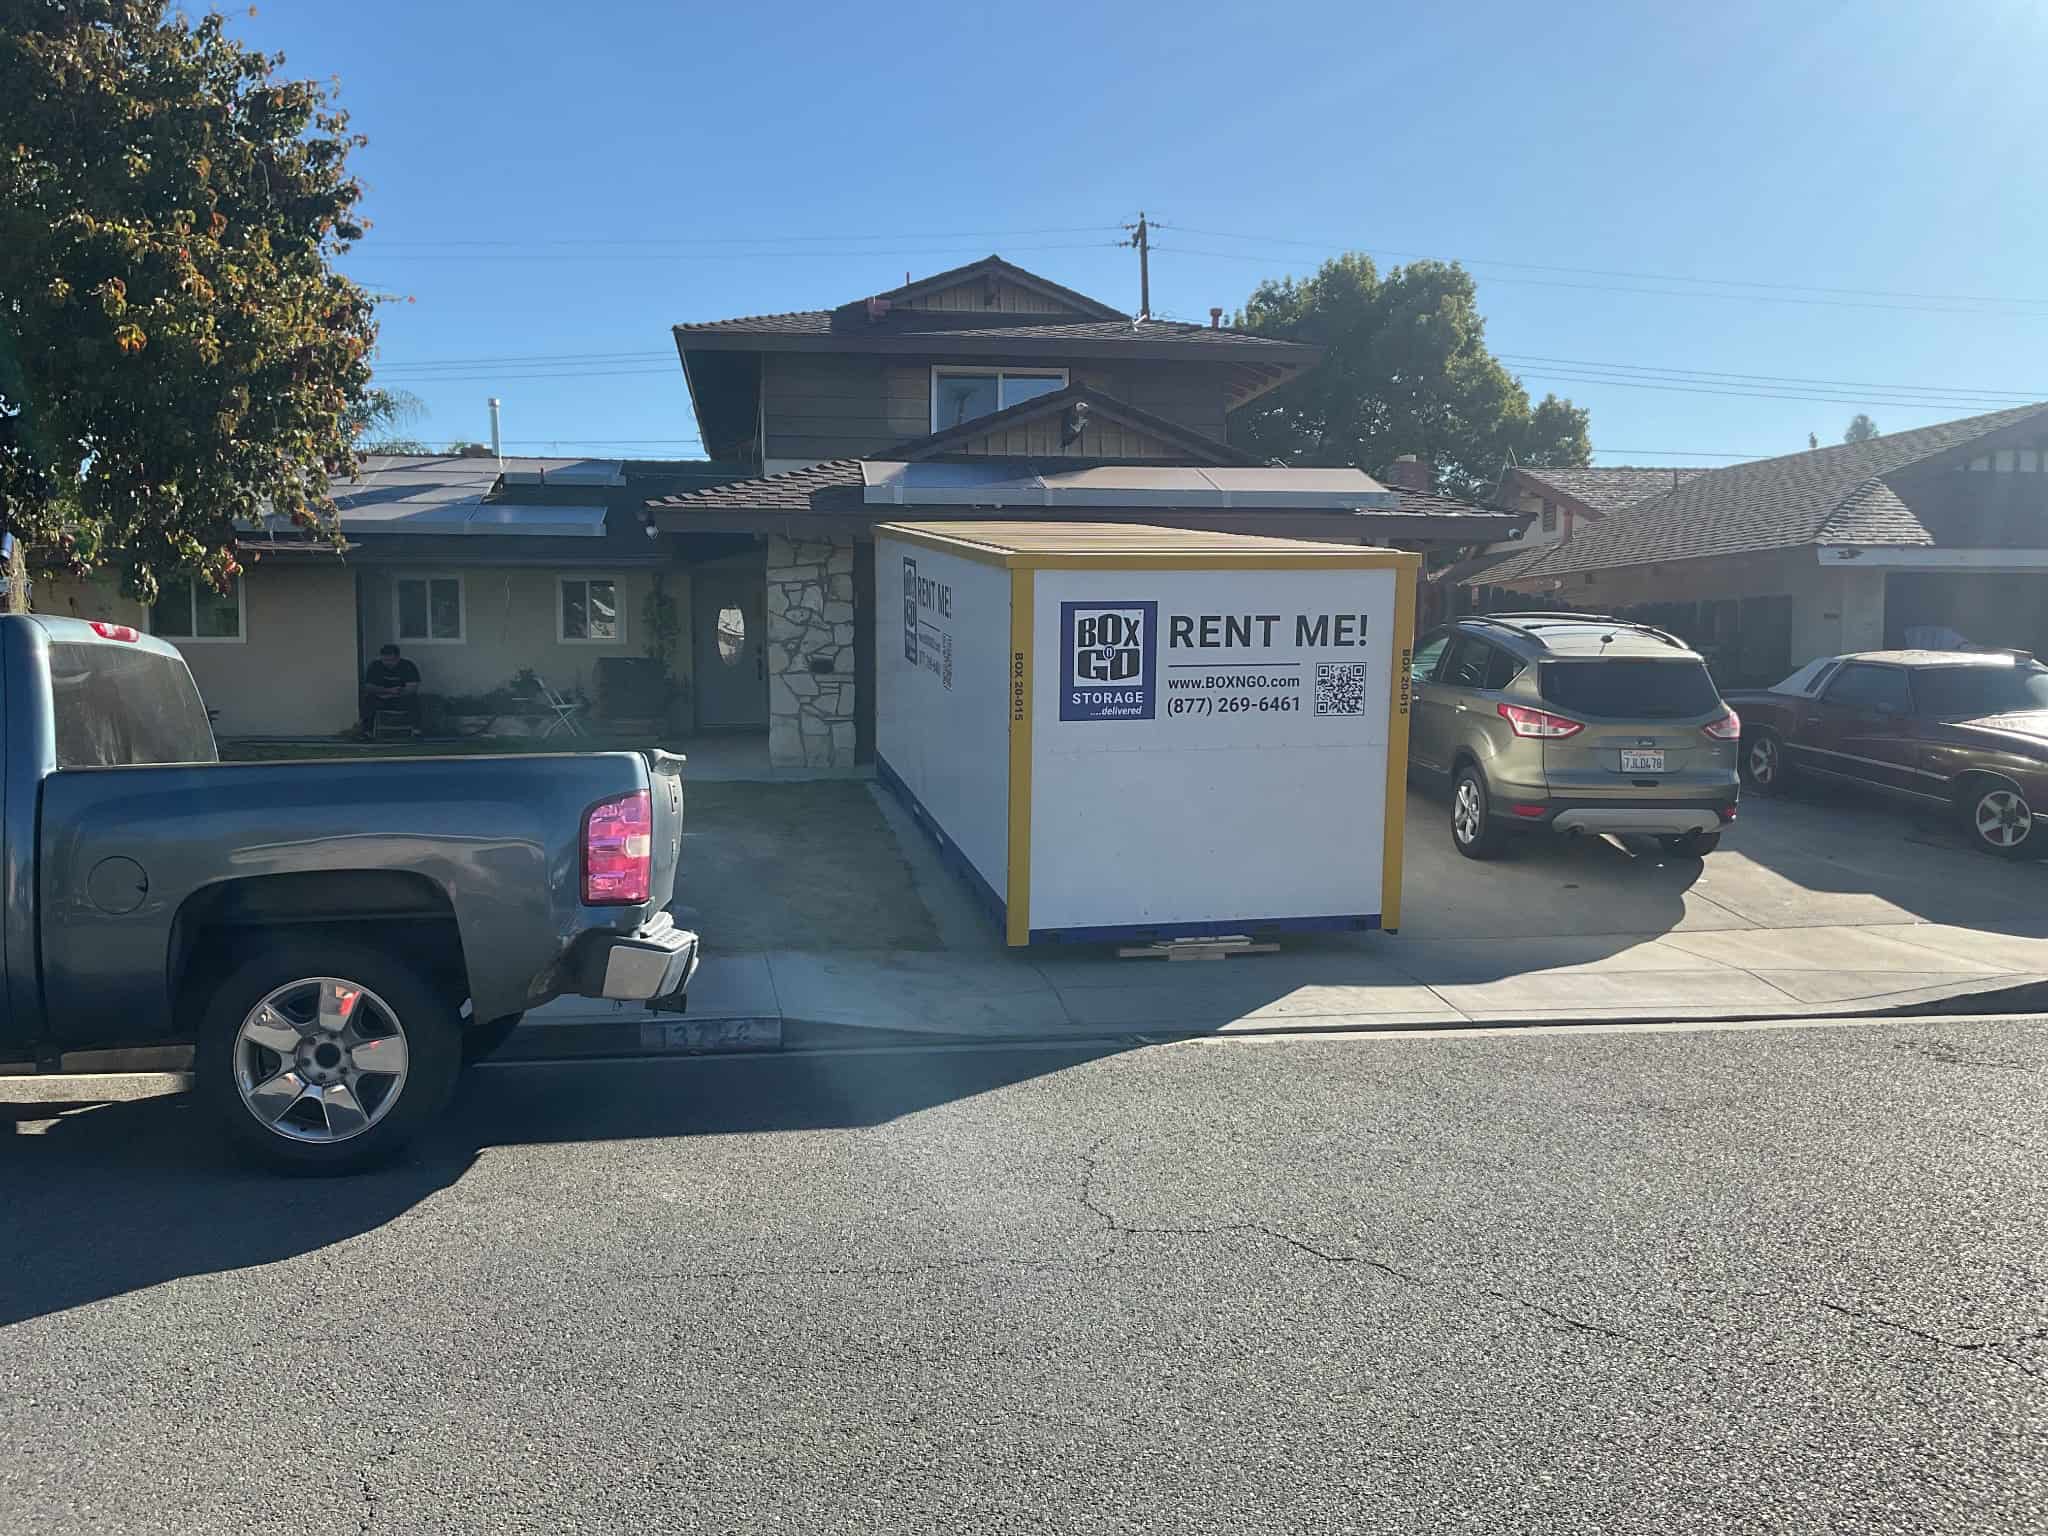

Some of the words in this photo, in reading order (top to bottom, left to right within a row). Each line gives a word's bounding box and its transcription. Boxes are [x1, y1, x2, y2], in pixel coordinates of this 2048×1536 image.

[918, 576, 935, 612] RENT
[938, 584, 952, 620] ME!
[1078, 613, 1140, 647] BOX
[1169, 615, 1280, 648] RENT
[1295, 614, 1368, 647] ME!
[1015, 652, 1024, 677] BOX
[1078, 648, 1140, 680] GO
[1400, 648, 1411, 672] BOX
[1168, 676, 1300, 689] www.BOXNGO.com
[1072, 692, 1144, 704] STORAGE
[1167, 697, 1212, 717] (877)
[1218, 697, 1300, 713] 269-6461
